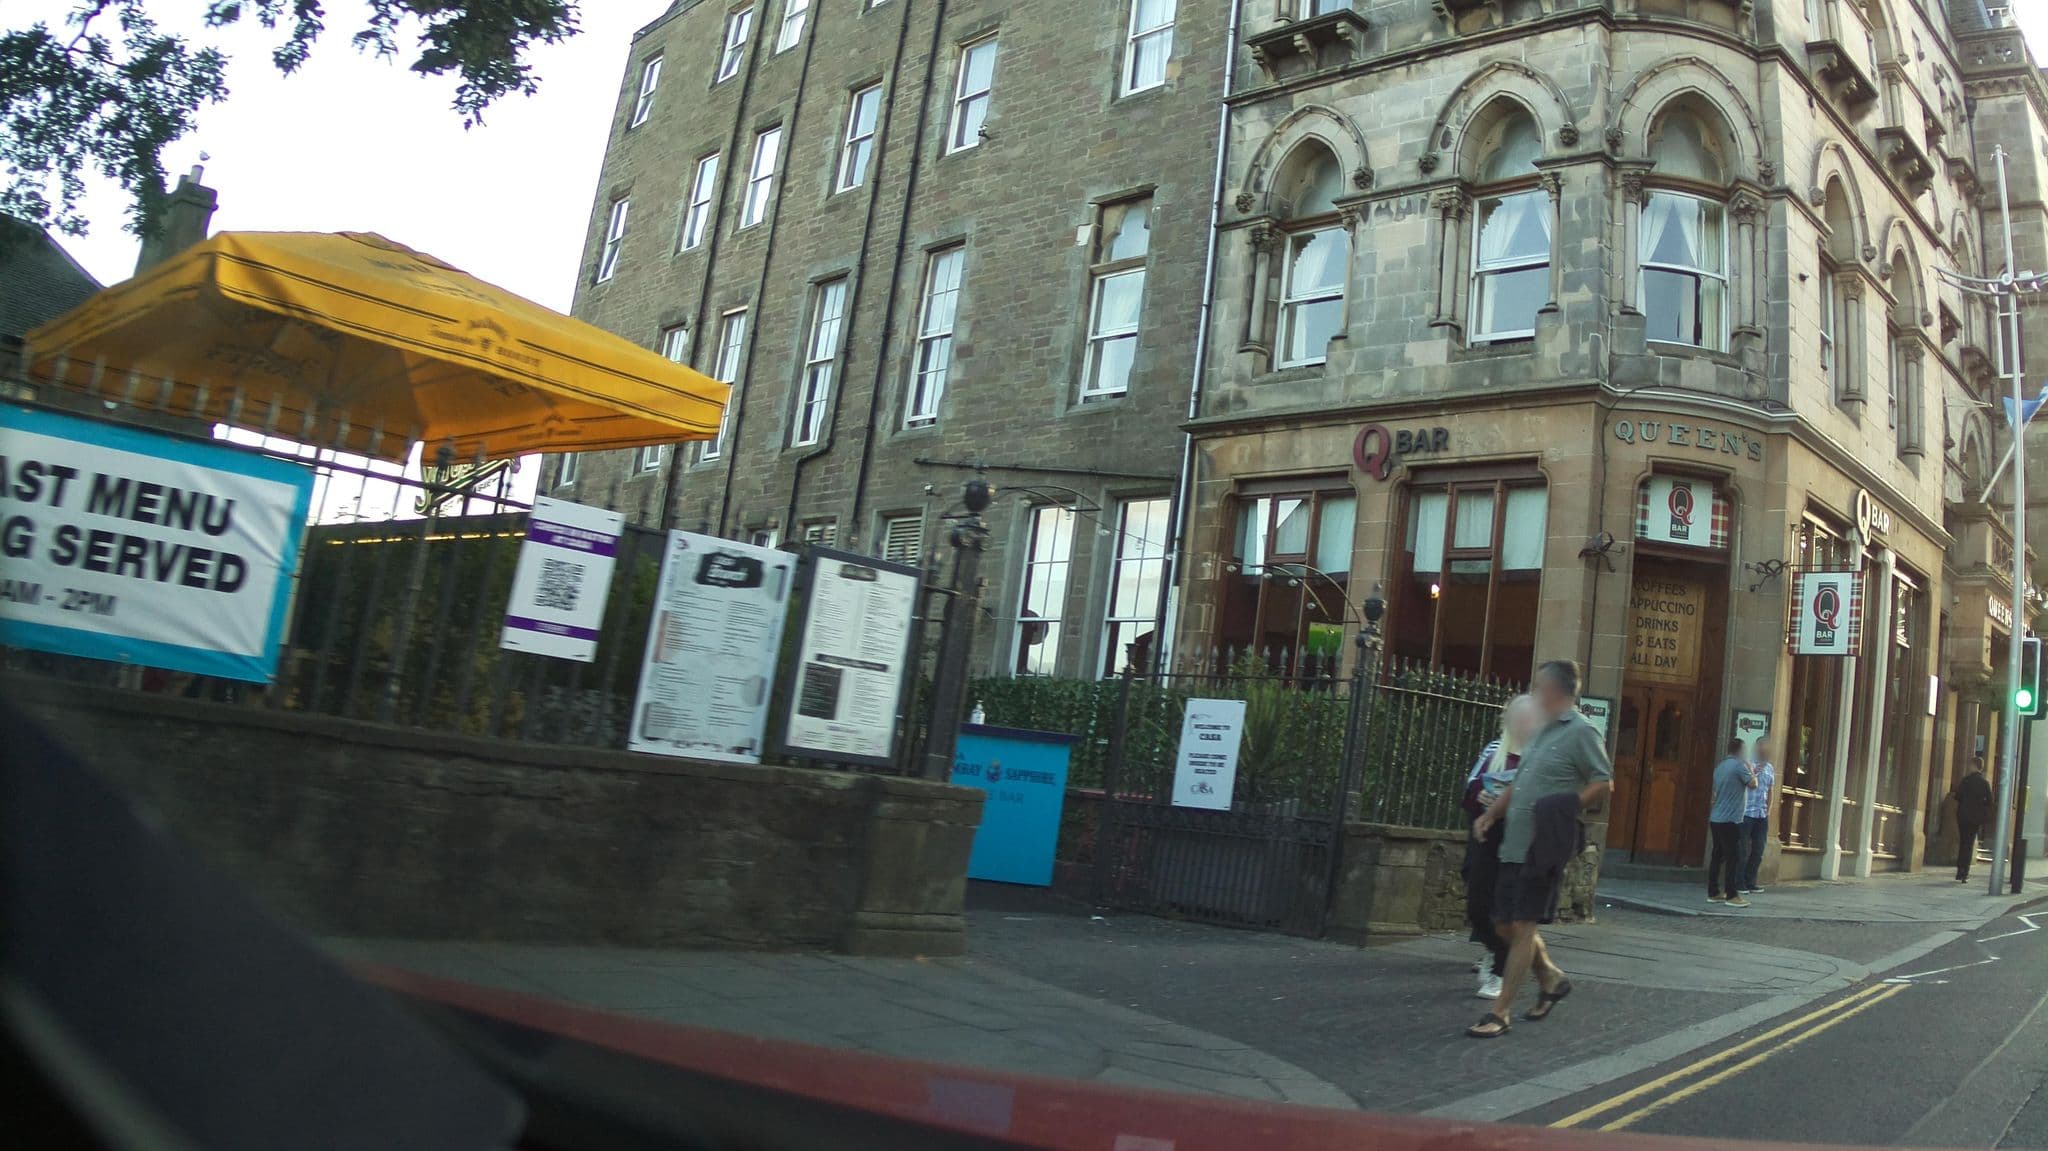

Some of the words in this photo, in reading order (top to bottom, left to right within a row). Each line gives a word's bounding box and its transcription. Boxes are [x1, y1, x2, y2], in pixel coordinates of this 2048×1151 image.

[1353, 423, 1392, 481] Q
[1395, 426, 1449, 454] BAR
[1615, 420, 1762, 461] QUEEN'S
[85, 472, 236, 537] MENU
[1667, 486, 1696, 526] Q
[1856, 488, 1871, 547] Q
[1871, 503, 1889, 536] BAR
[1671, 524, 1688, 532] BAR
[49, 524, 248, 594] SERVED
[59, 587, 117, 616] 2PM
[1812, 588, 1841, 630] Q
[1636, 616, 1680, 632] DRINKS
[1647, 637, 1677, 650] EATS
[1816, 631, 1833, 639] BAR
[1631, 651, 1648, 665] ALL
[1655, 655, 1678, 668] DAY
